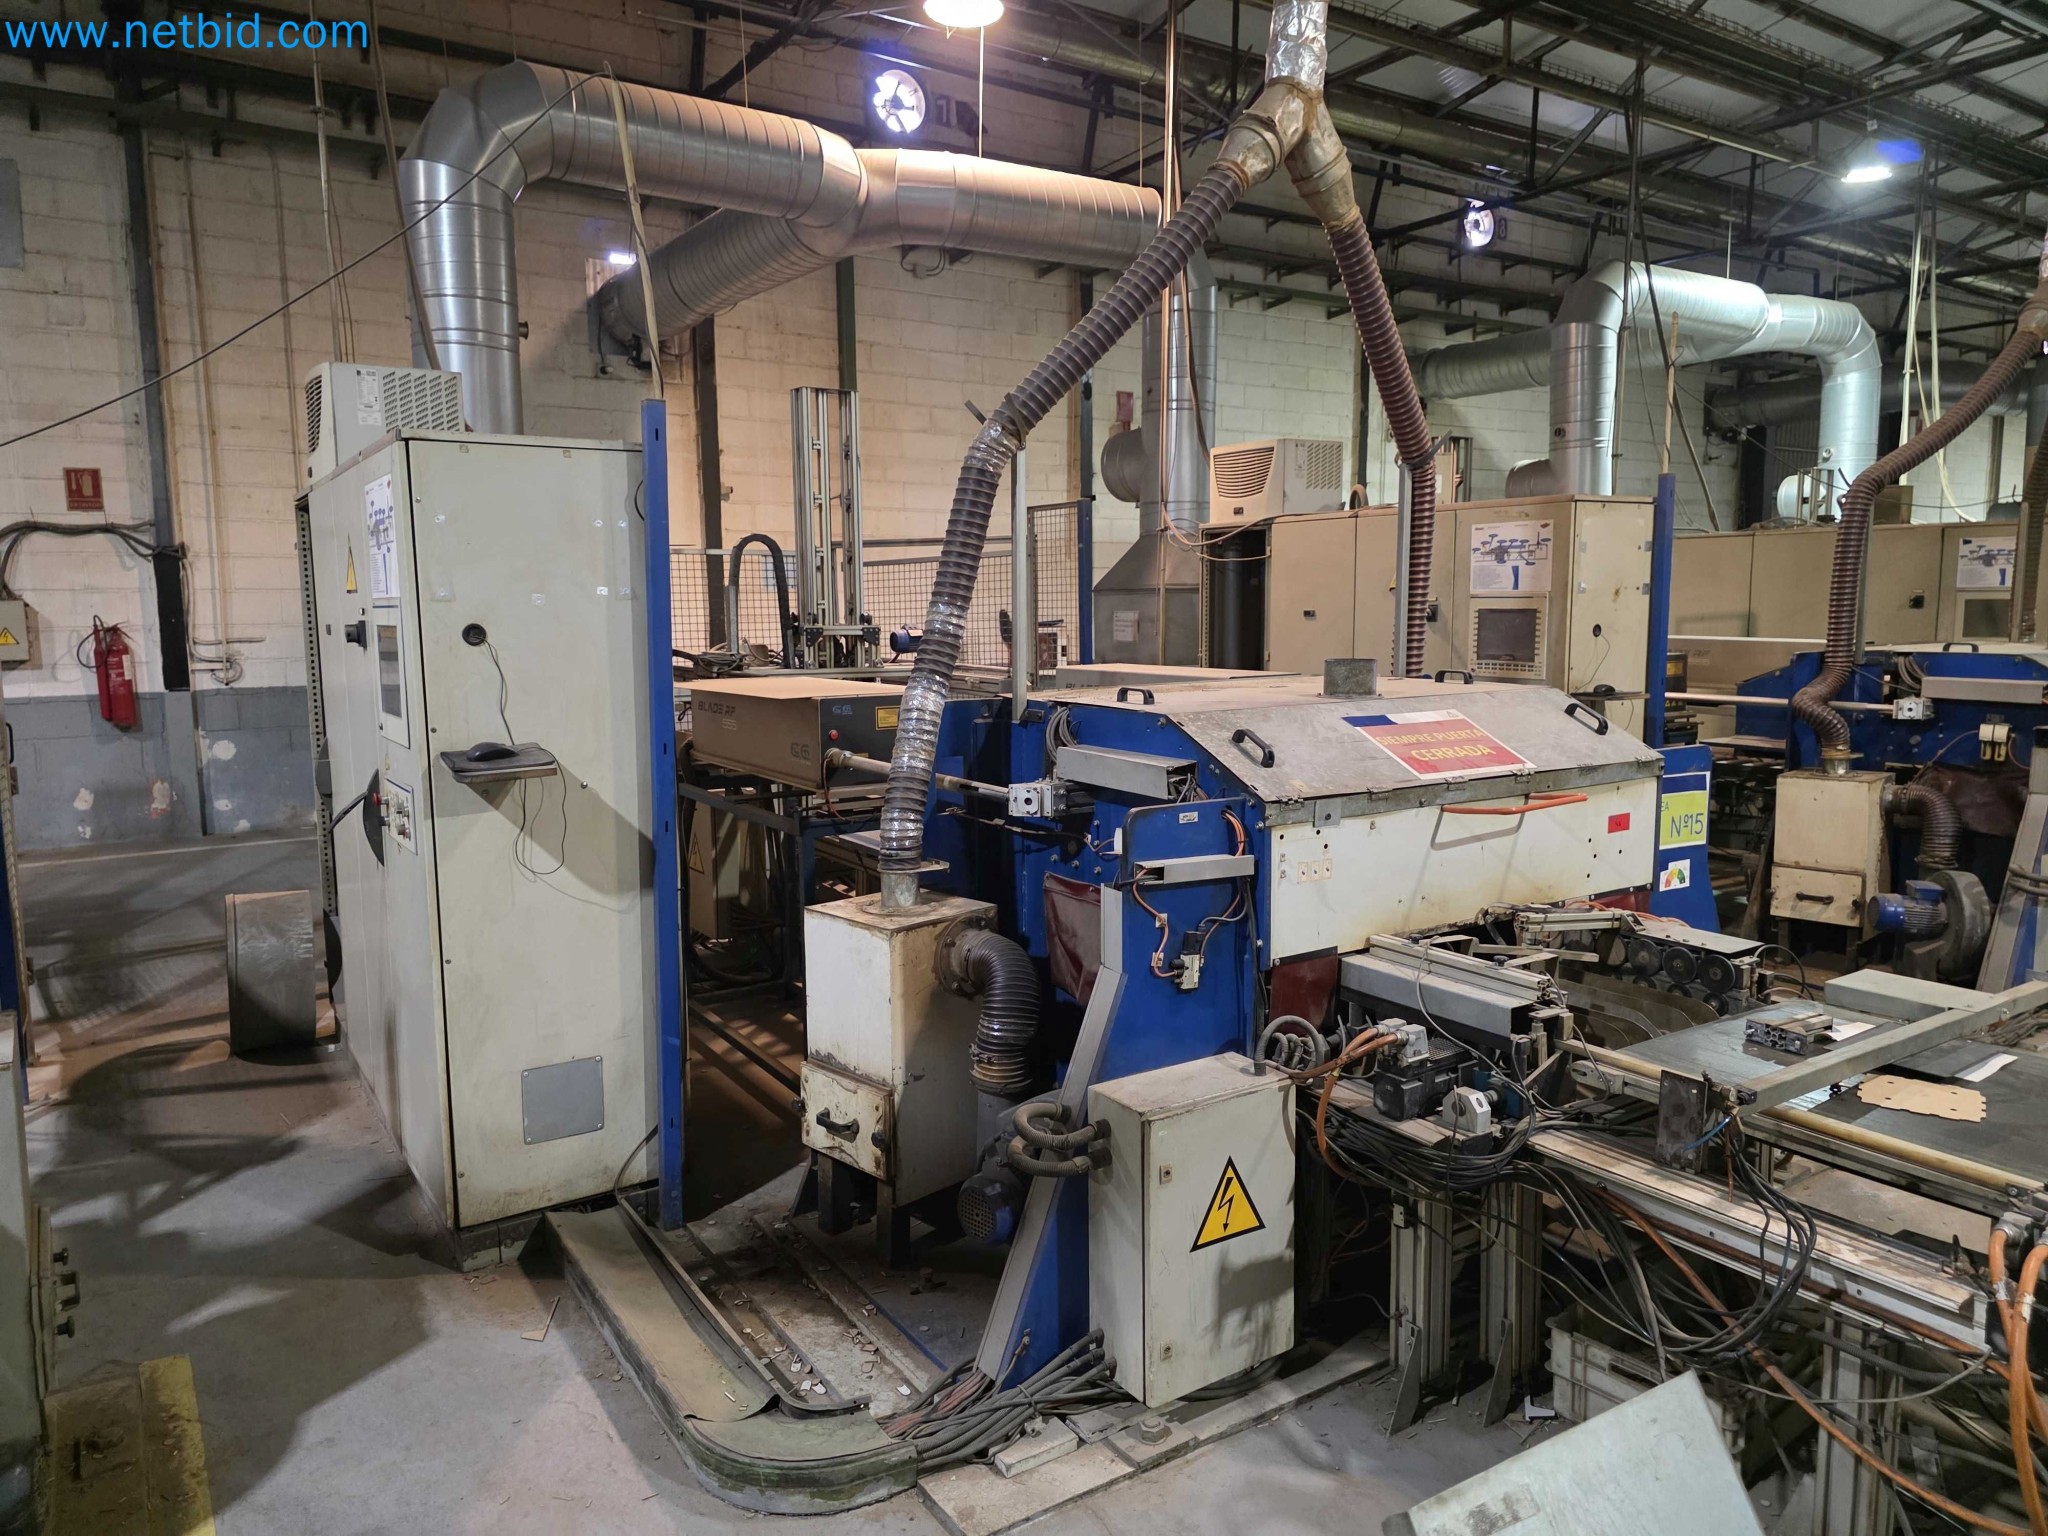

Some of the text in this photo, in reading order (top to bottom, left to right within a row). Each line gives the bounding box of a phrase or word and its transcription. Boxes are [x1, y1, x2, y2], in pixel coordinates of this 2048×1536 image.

[697, 701, 737, 717] BLADE RF
[1375, 728, 1488, 746] SIEMPRE PUERTA
[1411, 744, 1497, 761] CERRADA
